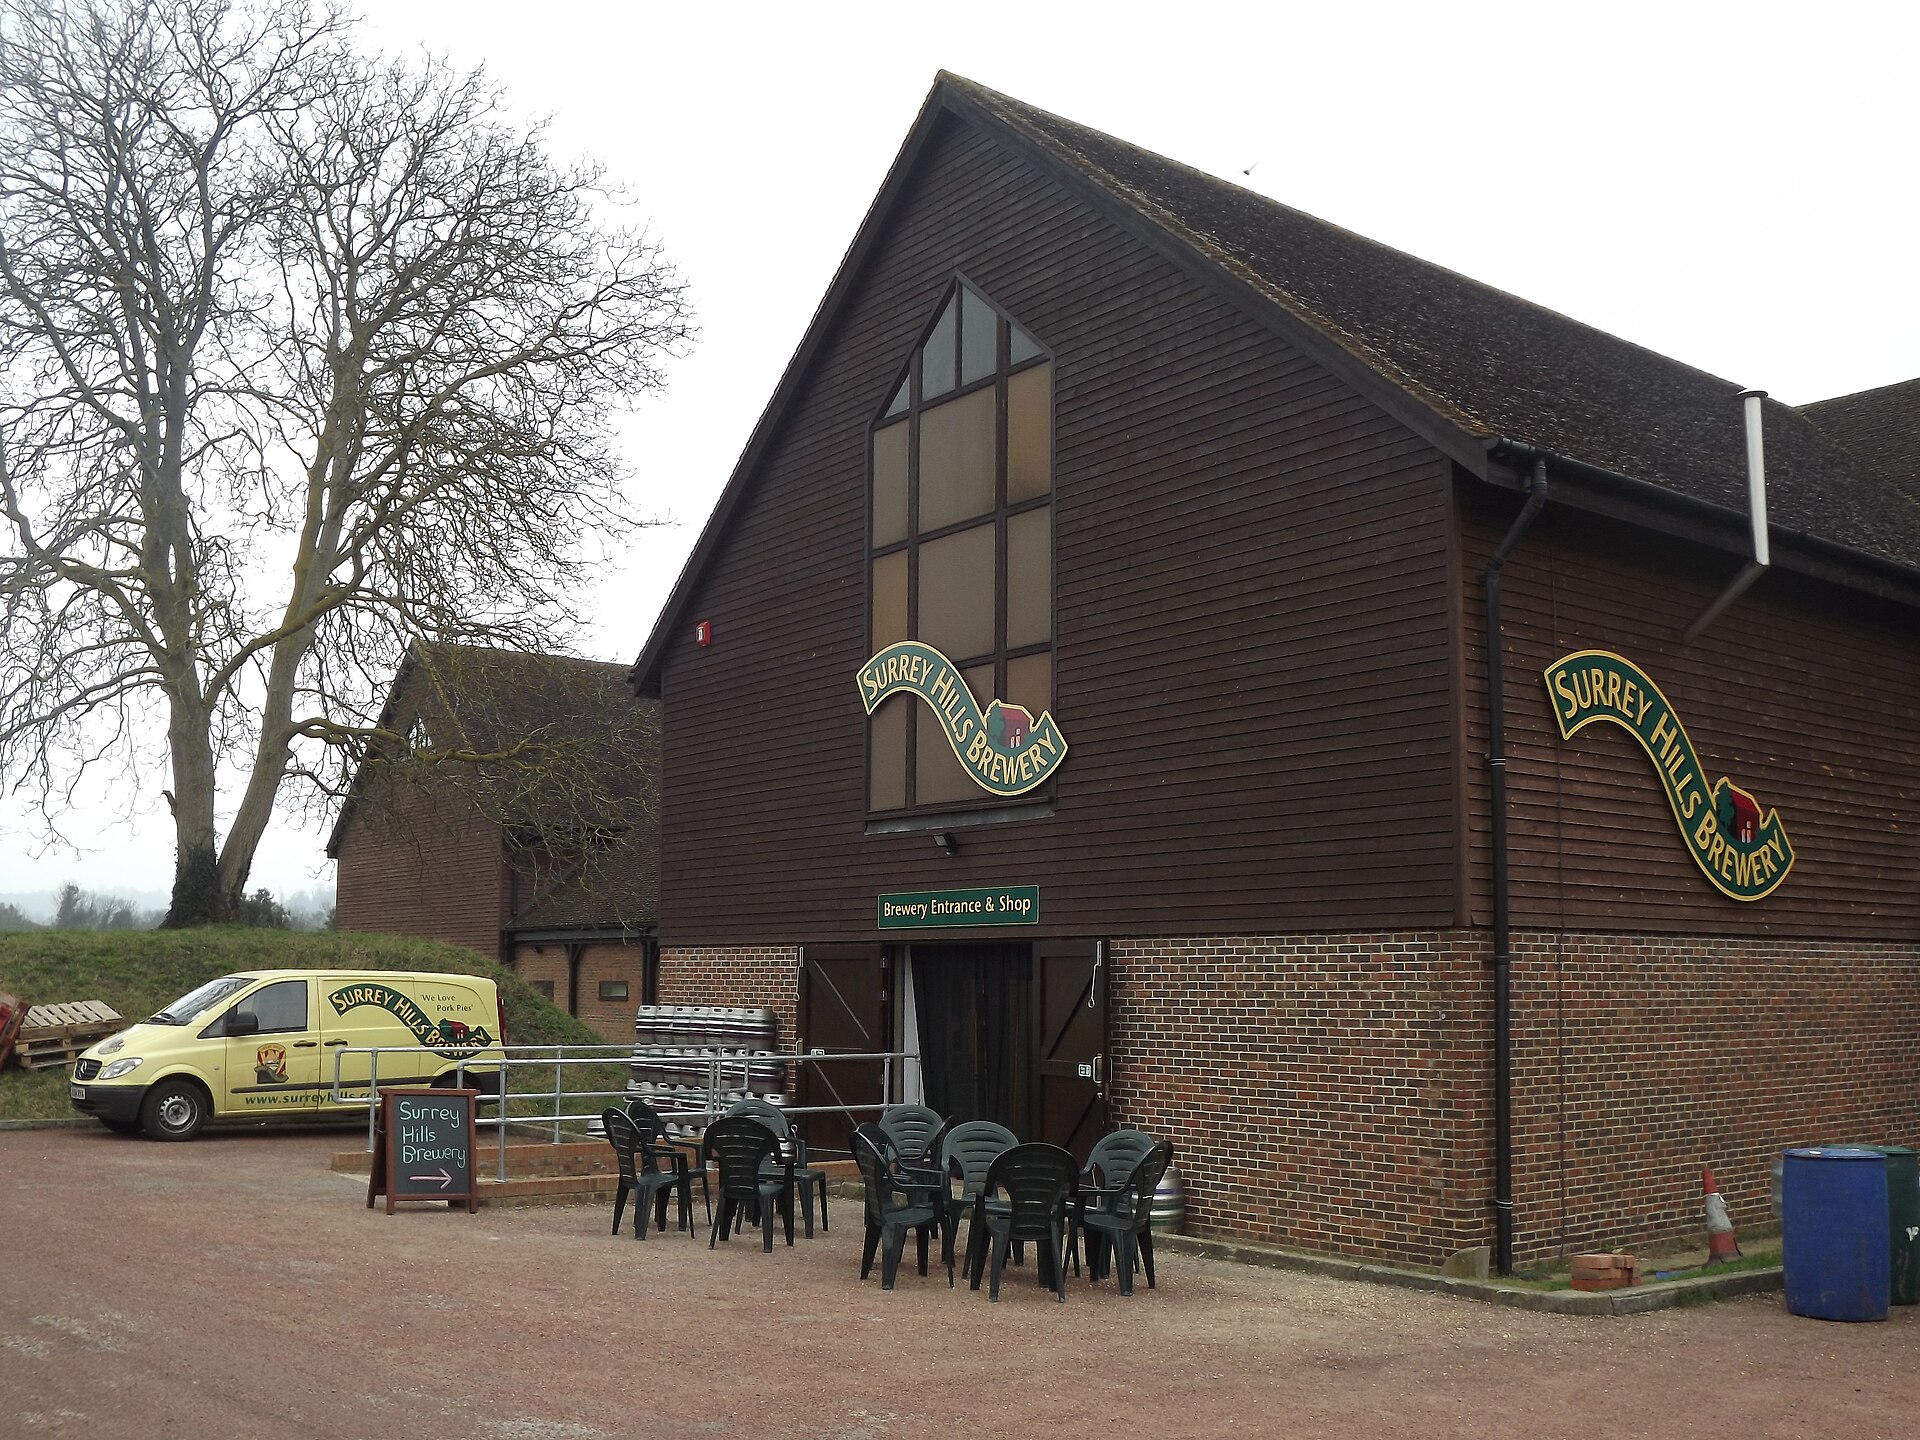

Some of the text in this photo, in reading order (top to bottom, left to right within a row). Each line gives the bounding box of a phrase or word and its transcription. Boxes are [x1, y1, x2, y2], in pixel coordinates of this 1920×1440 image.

[863, 654, 1057, 785] SURREY HILLS BREWERY
[1554, 668, 1786, 888] SURREY HILLS BREWERY
[884, 895, 1031, 920] Brewery Entrance & Shop
[437, 994, 456, 1002] Love
[437, 1004, 454, 1012] Pork
[331, 988, 394, 1012] SURREY
[393, 996, 430, 1036] HILLS
[399, 1101, 460, 1129] Surrey
[402, 1125, 437, 1144] Hills
[402, 1145, 466, 1169] Brewery
